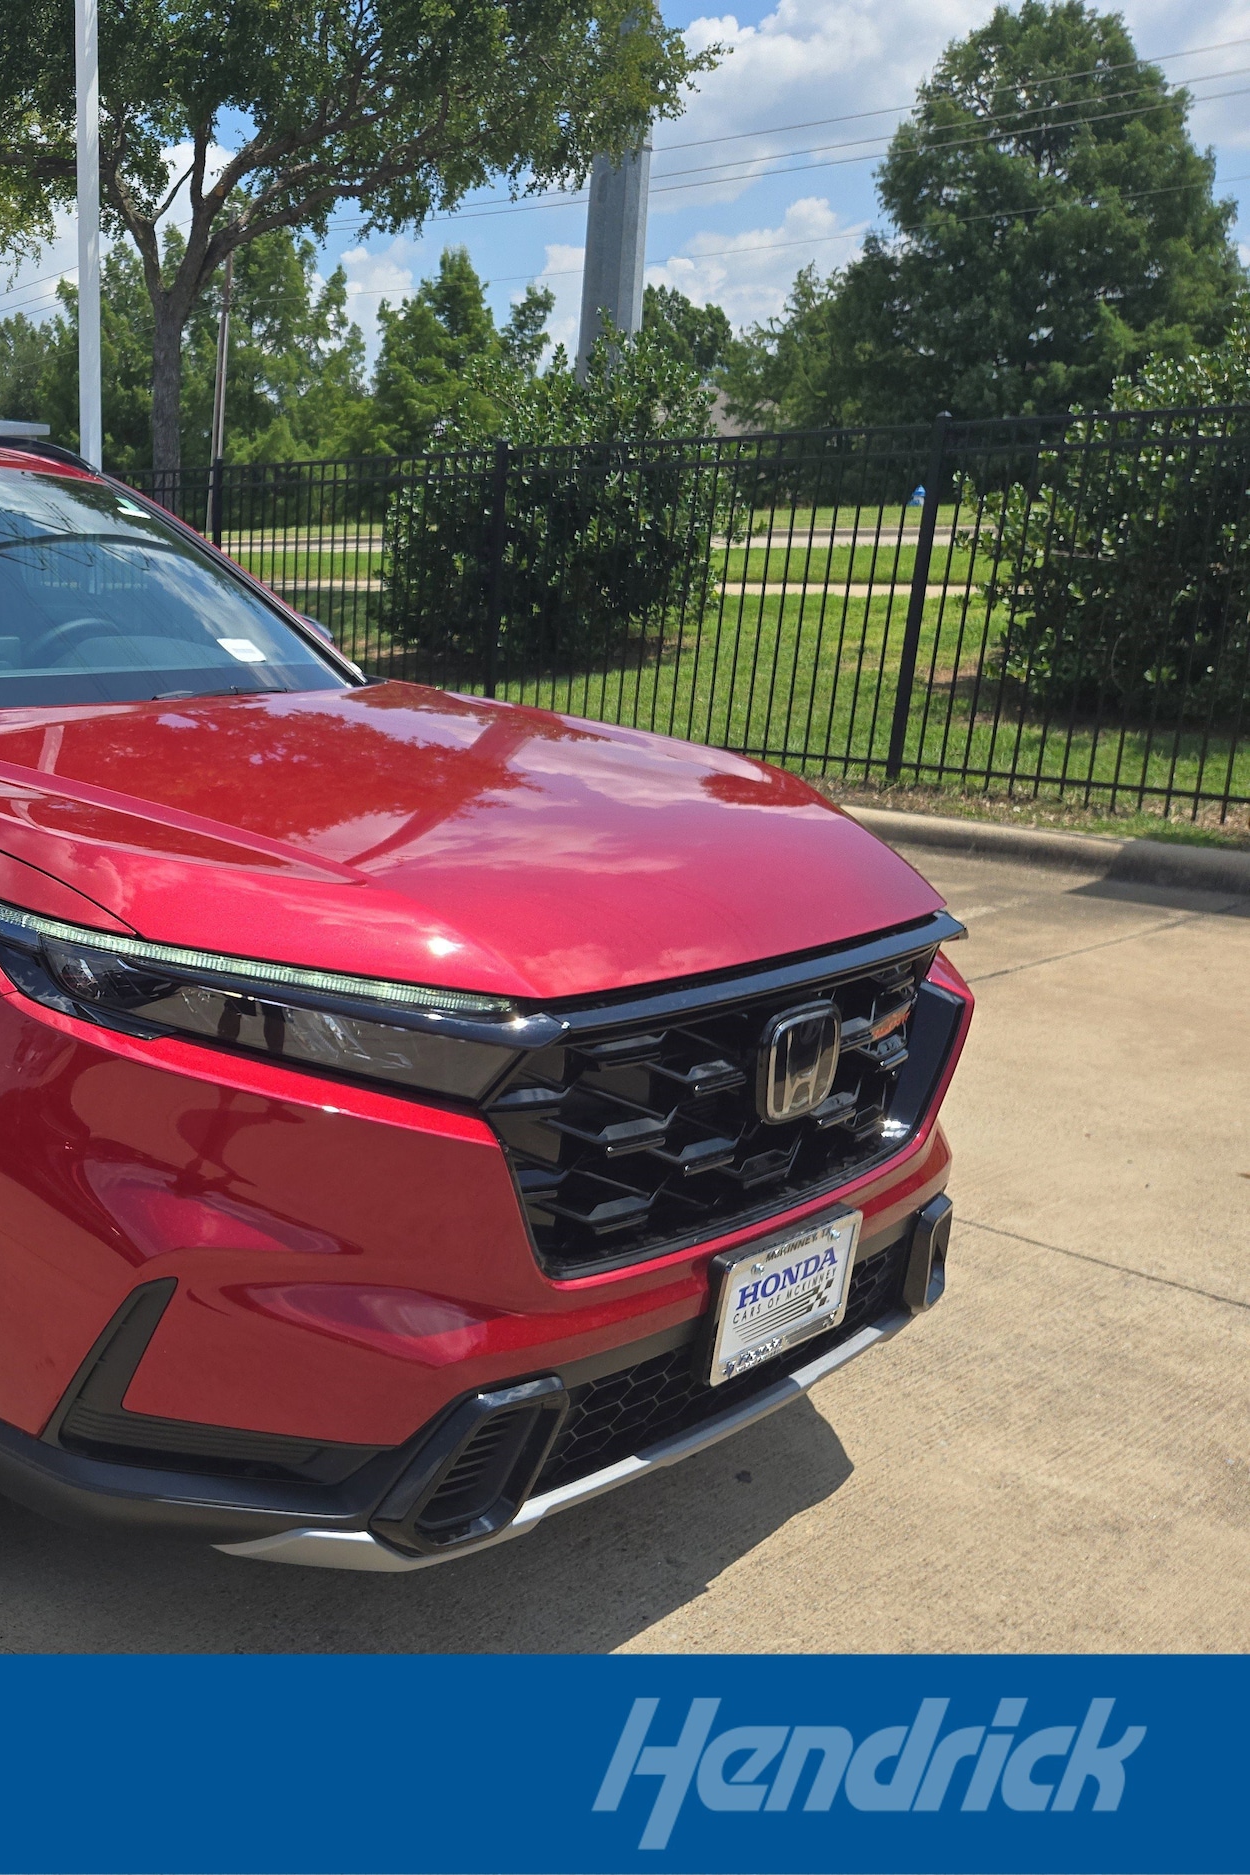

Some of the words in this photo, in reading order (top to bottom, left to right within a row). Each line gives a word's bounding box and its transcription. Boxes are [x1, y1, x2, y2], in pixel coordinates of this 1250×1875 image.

[732, 1303, 761, 1324] CARS
[767, 1293, 781, 1309] OF
[785, 1267, 837, 1300] MCKINNEY
[736, 1246, 838, 1311] HONDA
